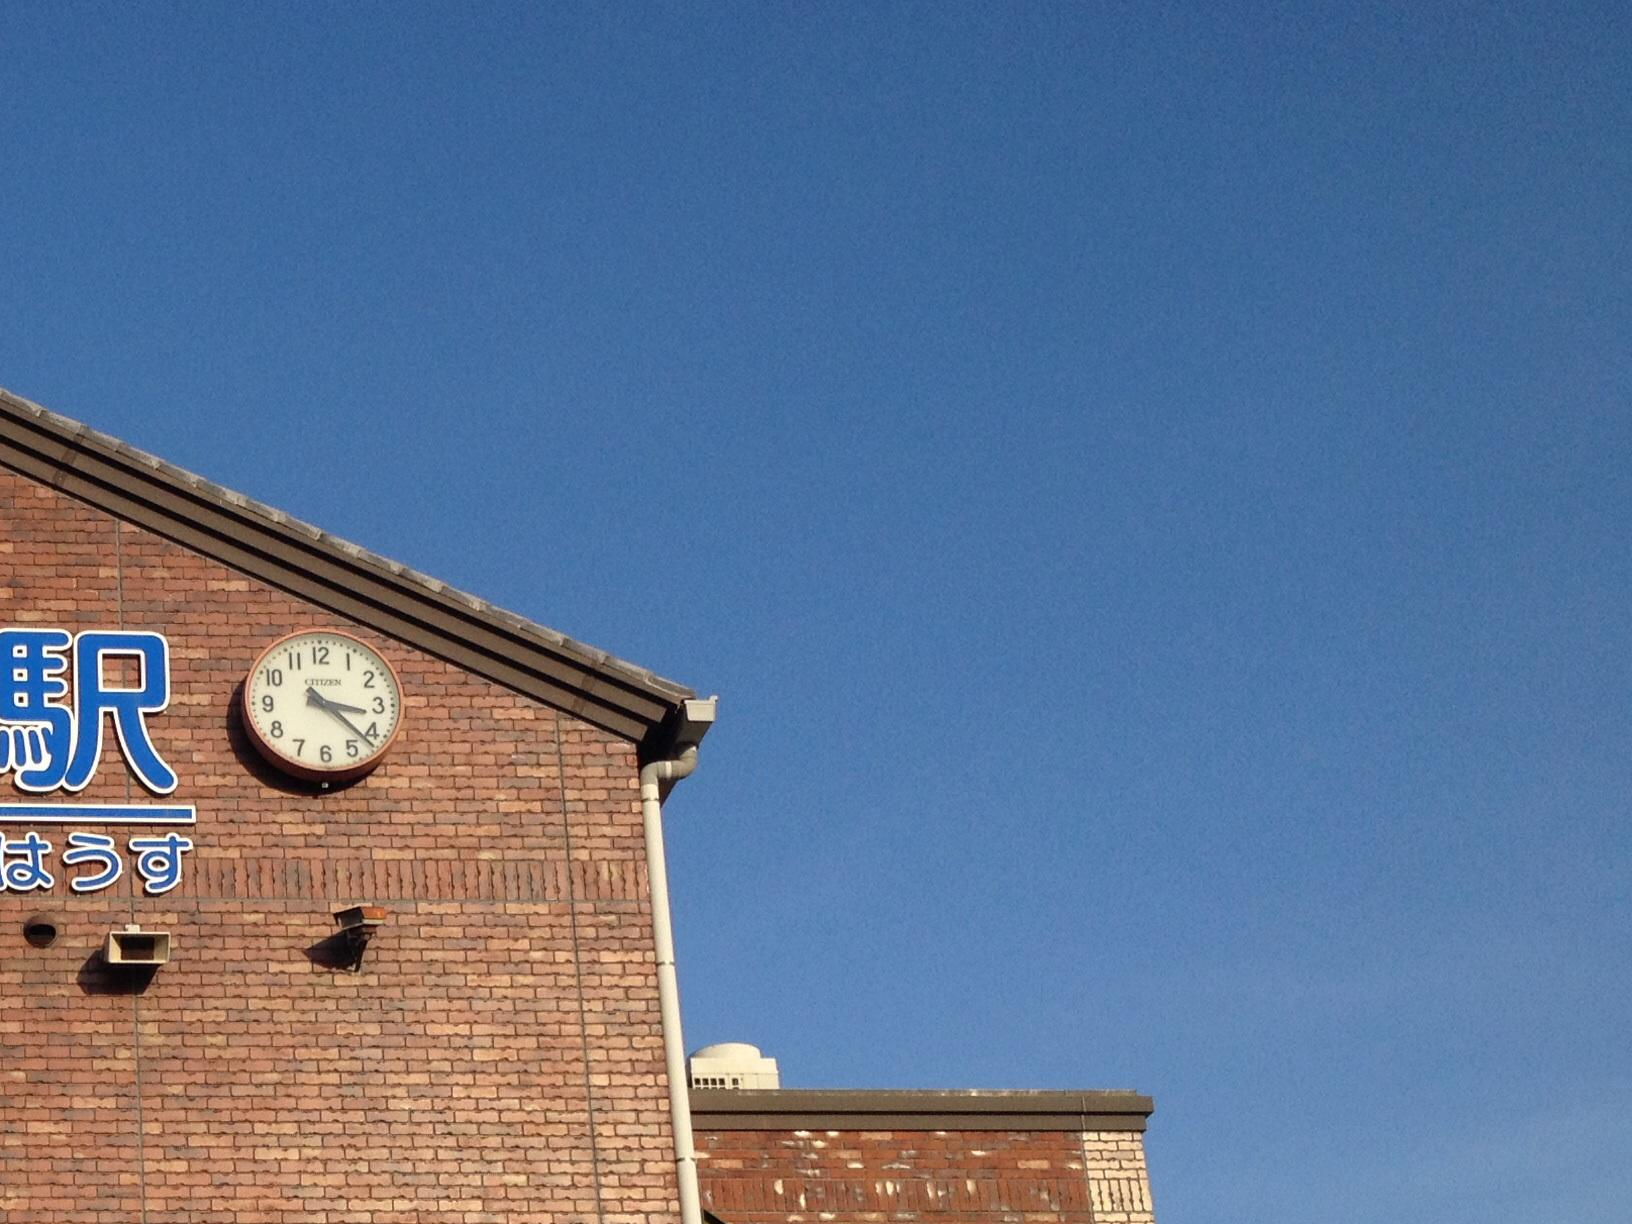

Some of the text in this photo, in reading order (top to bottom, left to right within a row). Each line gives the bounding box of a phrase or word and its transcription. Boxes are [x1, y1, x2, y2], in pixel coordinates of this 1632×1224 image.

[288, 652, 302, 671] 11
[312, 646, 330, 665] 12
[345, 652, 352, 671] 1
[266, 668, 283, 687] 10
[304, 678, 342, 687] CITIZEN
[363, 670, 376, 689] 2
[262, 695, 275, 713] 9
[372, 696, 386, 715] 3
[270, 720, 284, 739] 8
[365, 721, 380, 740] 4
[292, 738, 306, 757] 7
[319, 744, 333, 764] 6
[345, 739, 359, 758] 5
